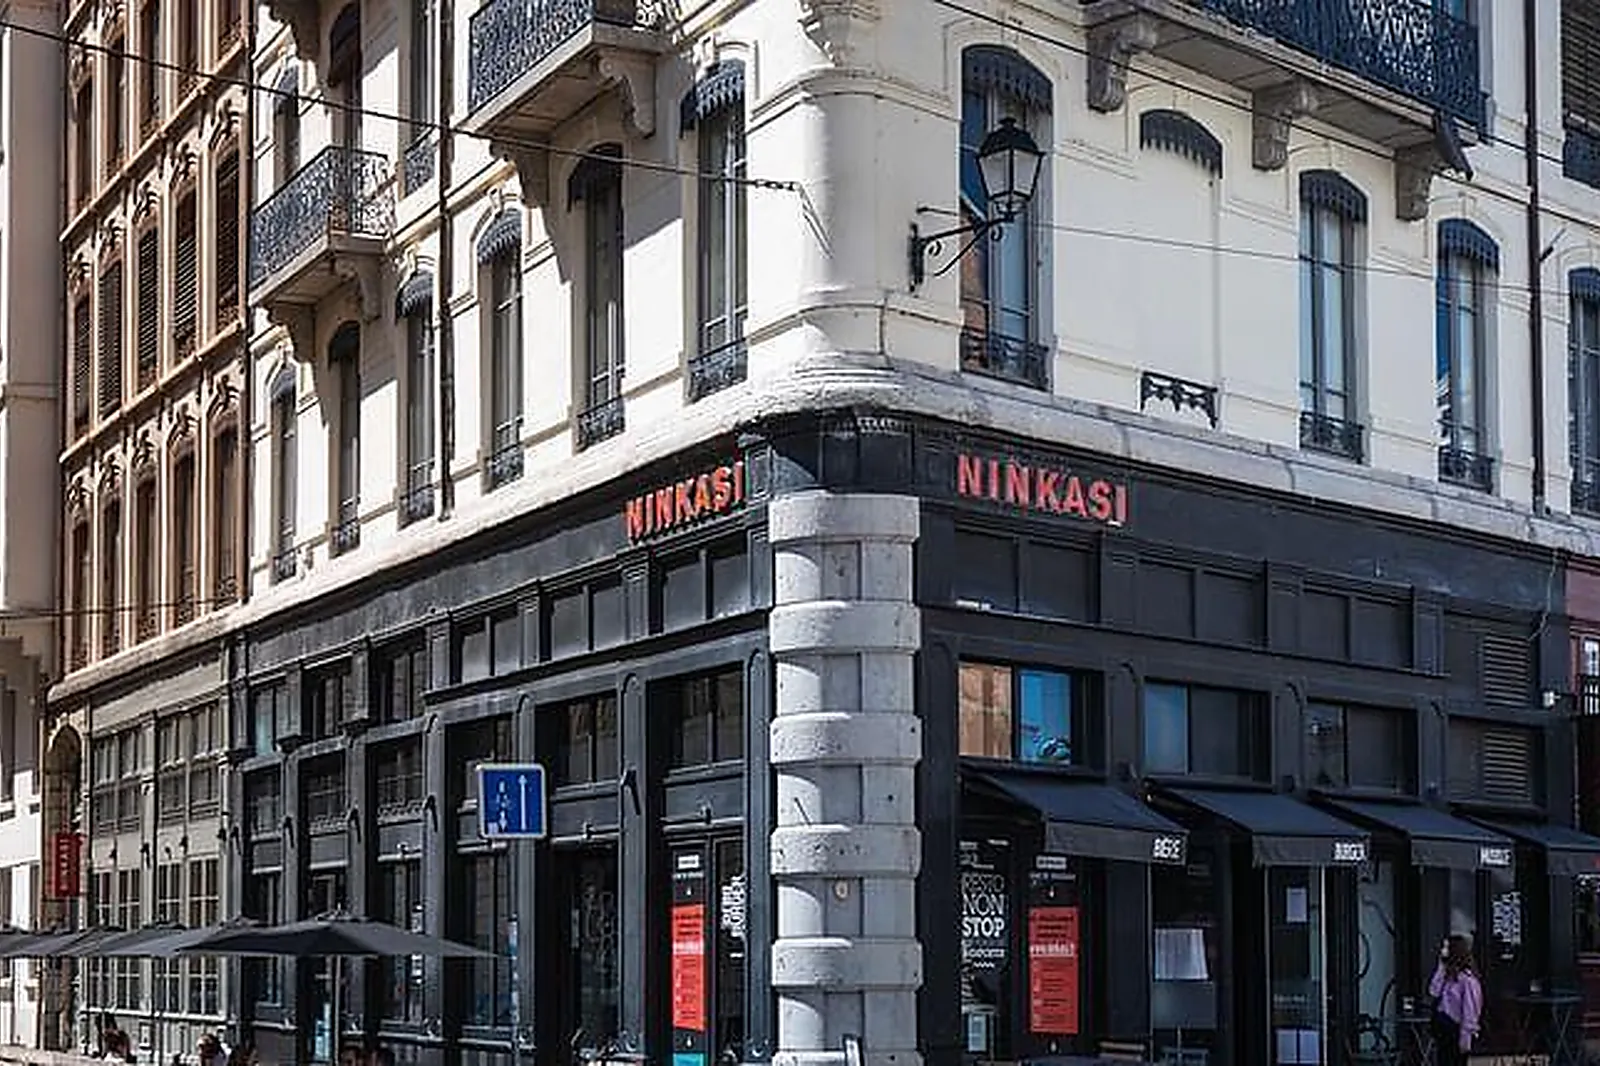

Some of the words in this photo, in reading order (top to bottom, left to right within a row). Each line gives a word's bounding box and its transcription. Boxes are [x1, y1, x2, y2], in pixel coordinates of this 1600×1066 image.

[626, 461, 744, 545] NINKASI
[958, 454, 1127, 522] NINKASI
[962, 893, 1005, 916] NON
[962, 916, 1005, 937] STOP
